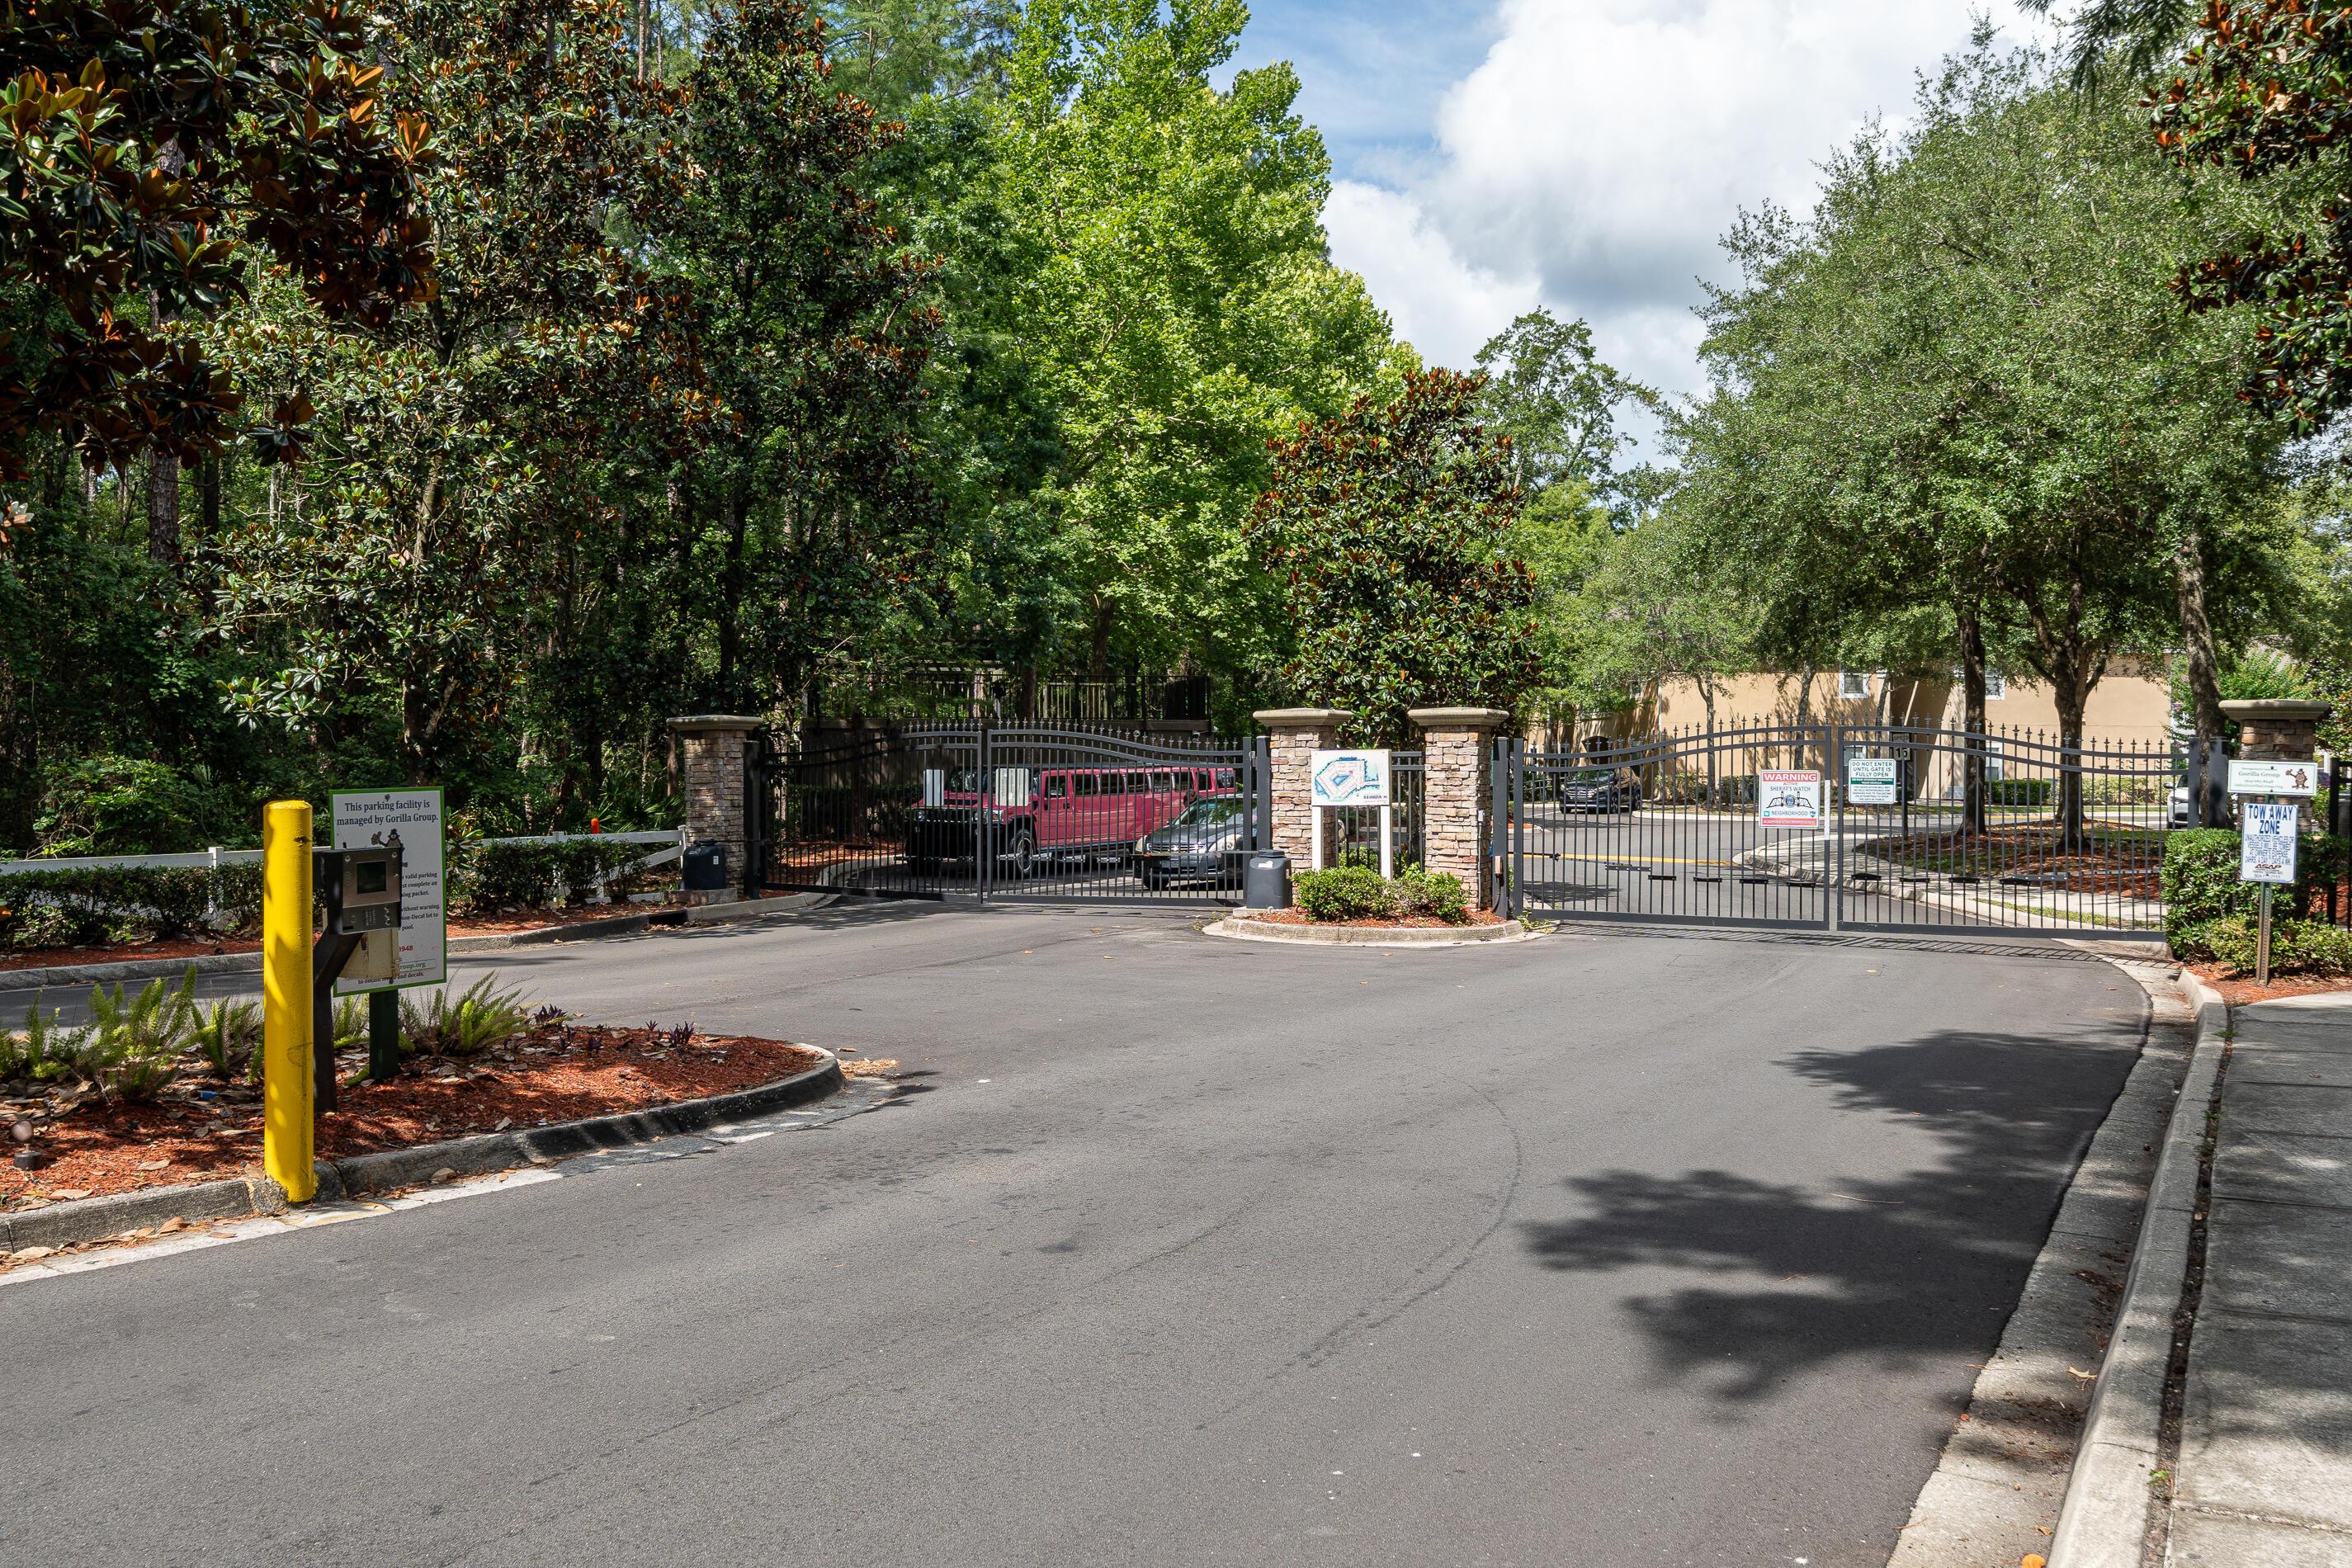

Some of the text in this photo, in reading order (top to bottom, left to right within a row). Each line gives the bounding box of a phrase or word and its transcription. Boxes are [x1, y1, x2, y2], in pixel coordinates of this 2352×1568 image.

[345, 800, 430, 813] This parking facility is
[2249, 805, 2293, 821] TOW AWAY
[336, 814, 438, 827] managed by Gorilla Group.
[2259, 820, 2280, 835] ZONE
